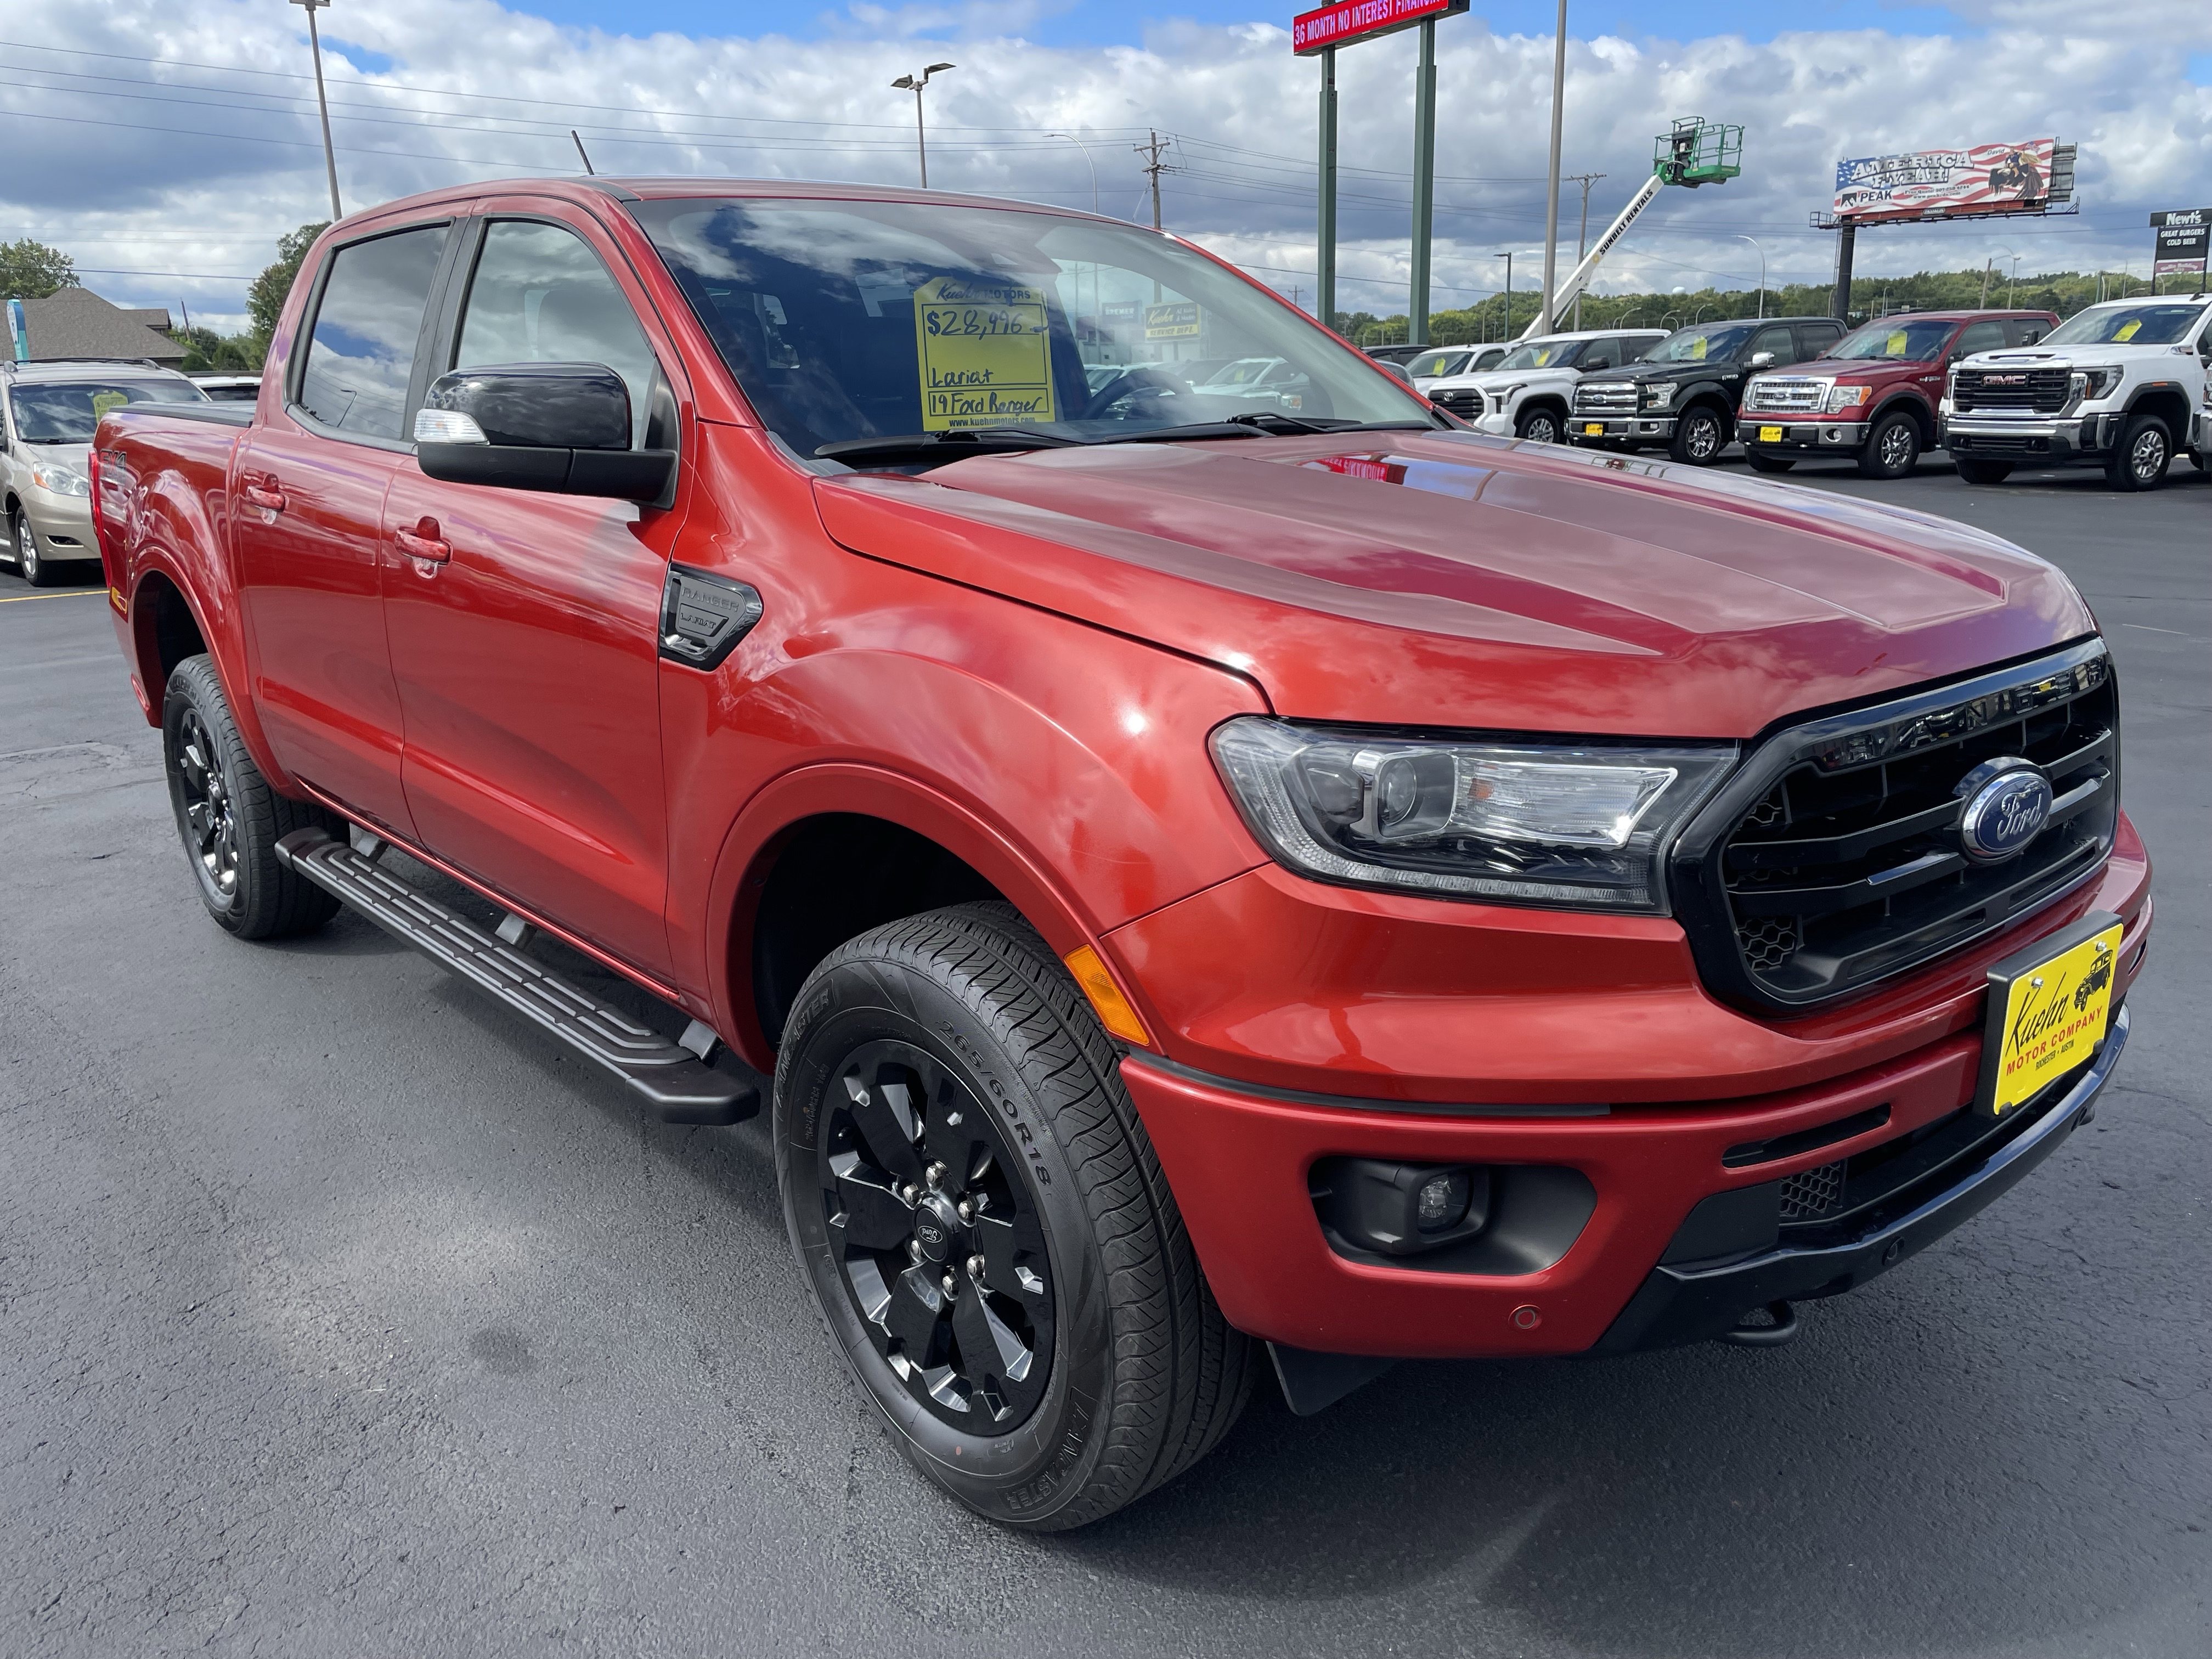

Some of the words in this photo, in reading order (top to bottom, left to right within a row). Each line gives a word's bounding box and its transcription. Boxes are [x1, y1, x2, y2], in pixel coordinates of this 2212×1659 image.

[1295, 24, 1305, 45] 36
[1307, 14, 1335, 41] MONTH
[1339, 9, 1349, 32] NO
[1352, 0, 1392, 28] INTEREST
[1851, 151, 1974, 181] AMERICA
[1860, 190, 1893, 202] PEAK
[1599, 221, 1627, 255] SUNBELT
[1626, 189, 1653, 223] RENTALS
[2166, 210, 2202, 225] Newt's
[2179, 228, 2205, 236] BURGERS
[1150, 328, 1174, 336] SERVICE
[932, 367, 994, 386] Lariat
[1983, 375, 2026, 385] GMC
[932, 394, 947, 413] 19
[951, 392, 984, 414] Ford
[989, 391, 1042, 416] Ranger
[949, 417, 1035, 427] www.kuehnmotors.com
[100, 448, 127, 478] FX4
[681, 587, 739, 612] RANGER
[680, 613, 716, 628] LARIAT
[1996, 788, 2042, 842] Ford
[2005, 972, 2069, 1057] Kuehn
[2006, 1043, 2046, 1076] MOTOR
[2051, 1006, 2102, 1046] COMPANY
[2035, 1050, 2056, 1071] ROCHESTER
[2061, 1040, 2074, 1054] AUSTIN
[939, 1020, 1052, 1186] 265/60R18
[922, 1228, 938, 1241] Ford
